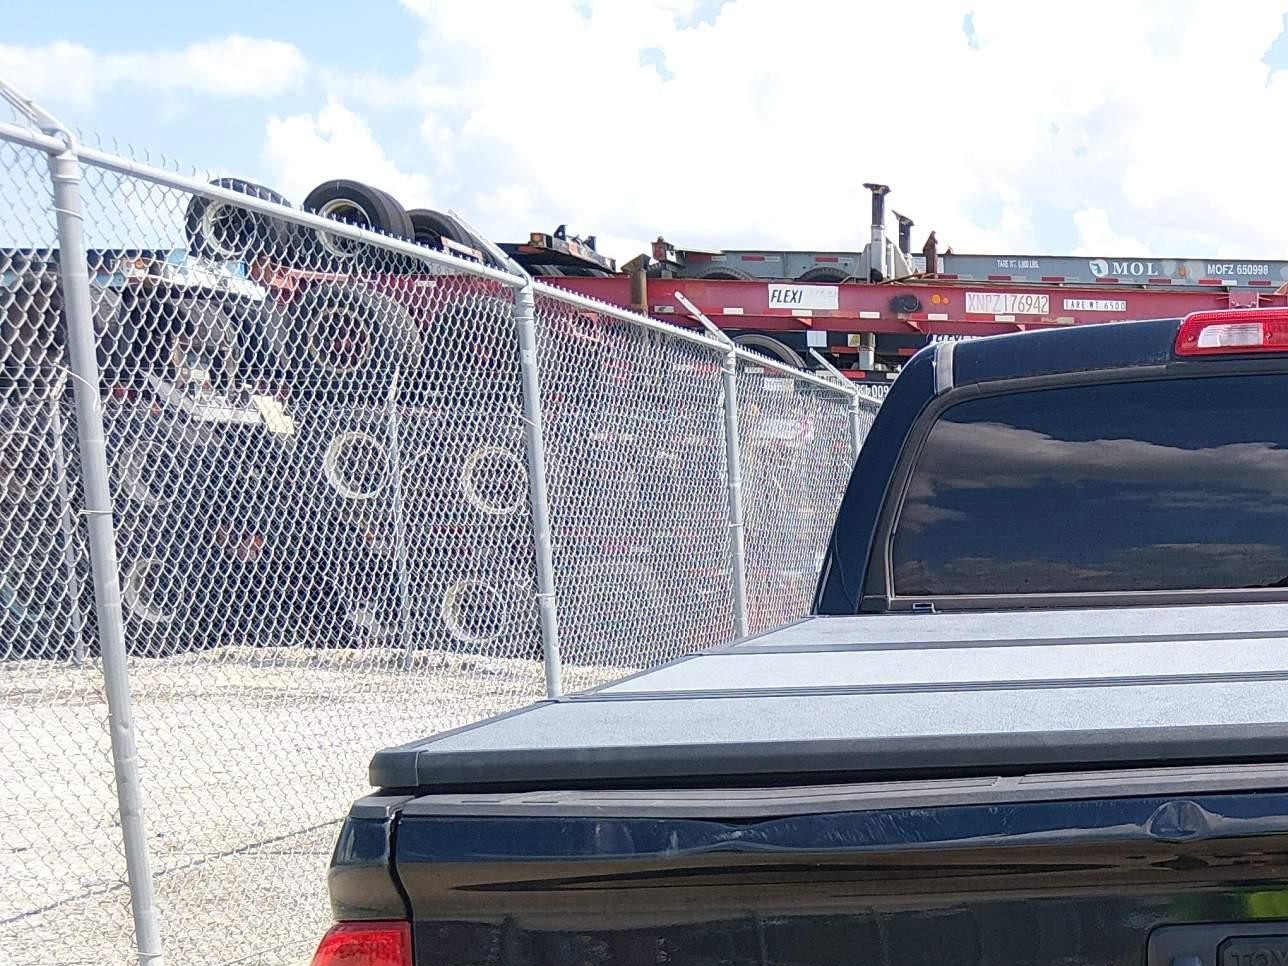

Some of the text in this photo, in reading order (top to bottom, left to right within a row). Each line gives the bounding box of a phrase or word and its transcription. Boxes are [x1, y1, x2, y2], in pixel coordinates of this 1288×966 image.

[1112, 262, 1158, 276] MOL
[1207, 264, 1269, 276] MOFZ 650998
[770, 289, 803, 304] FLEXI
